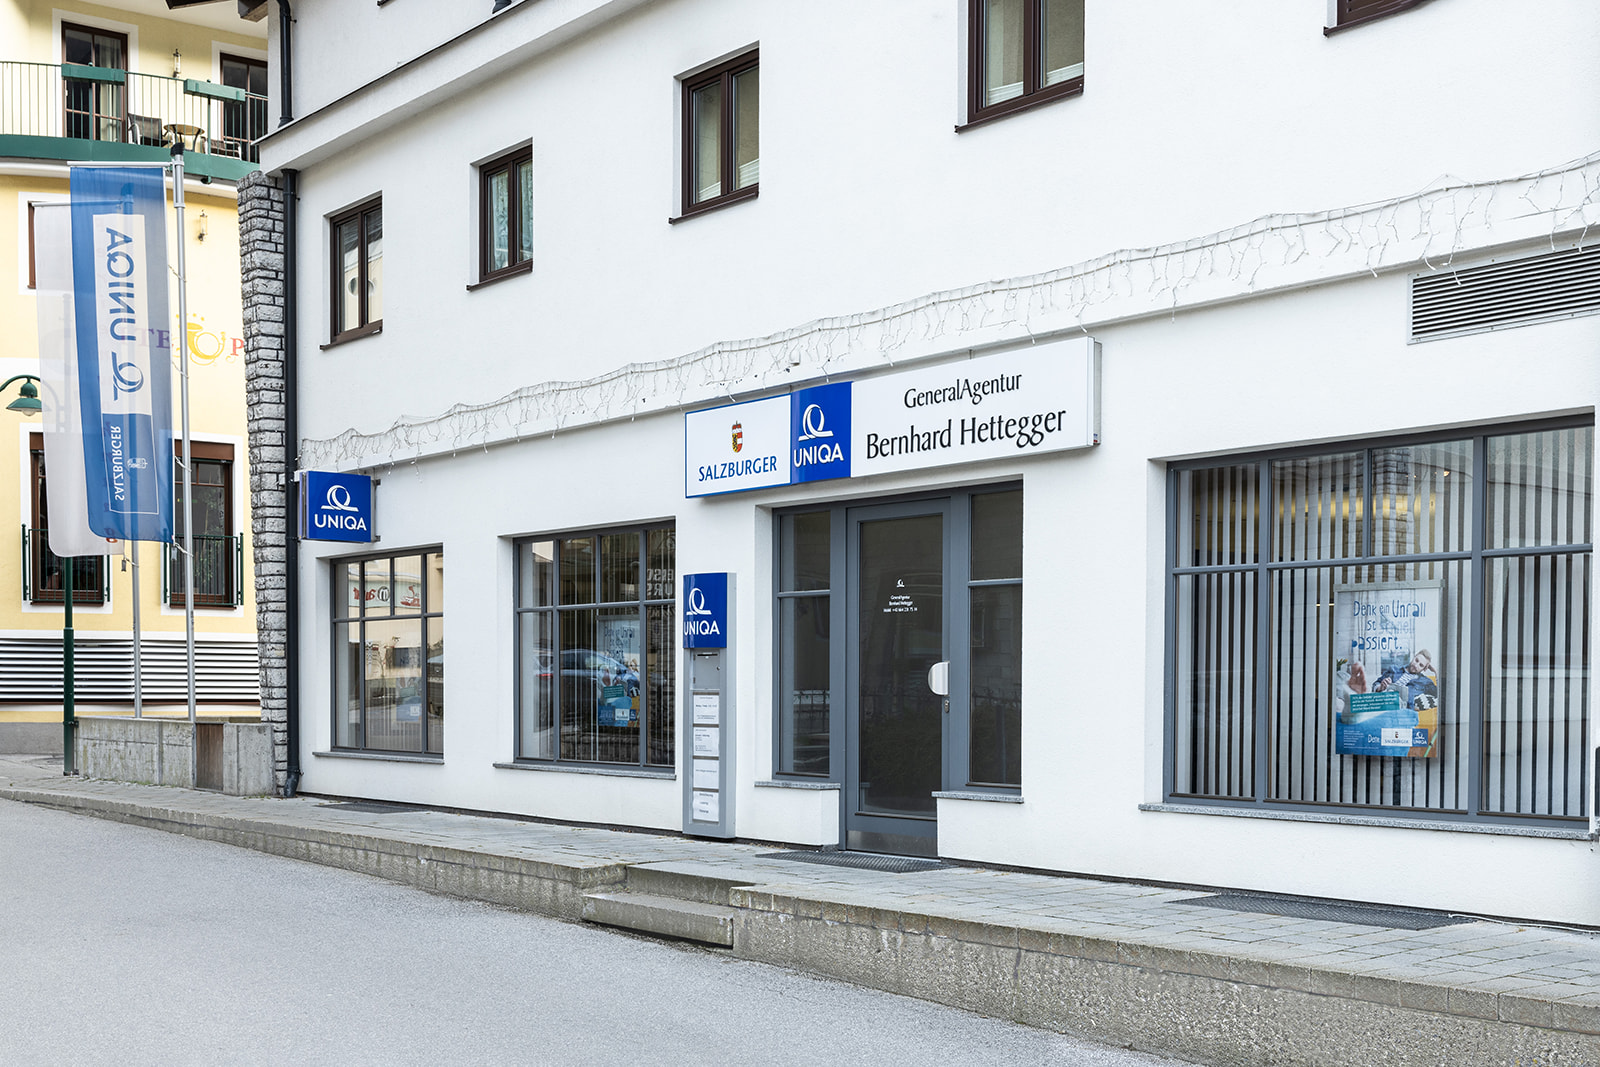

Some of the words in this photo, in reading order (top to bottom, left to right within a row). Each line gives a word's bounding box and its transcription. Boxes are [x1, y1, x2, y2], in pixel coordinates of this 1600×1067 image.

[904, 373, 1022, 408] GeneralAgentur
[866, 418, 952, 460] Bernhard
[960, 409, 1067, 448] Hettegger
[793, 444, 844, 467] UNIQA
[698, 455, 777, 482] SALZBURGER
[314, 513, 367, 532] UNIQA
[1353, 600, 1377, 617] Denk
[1379, 604, 1390, 614] ein
[683, 620, 721, 635] UNIQA
[1351, 636, 1403, 654] passiert.
